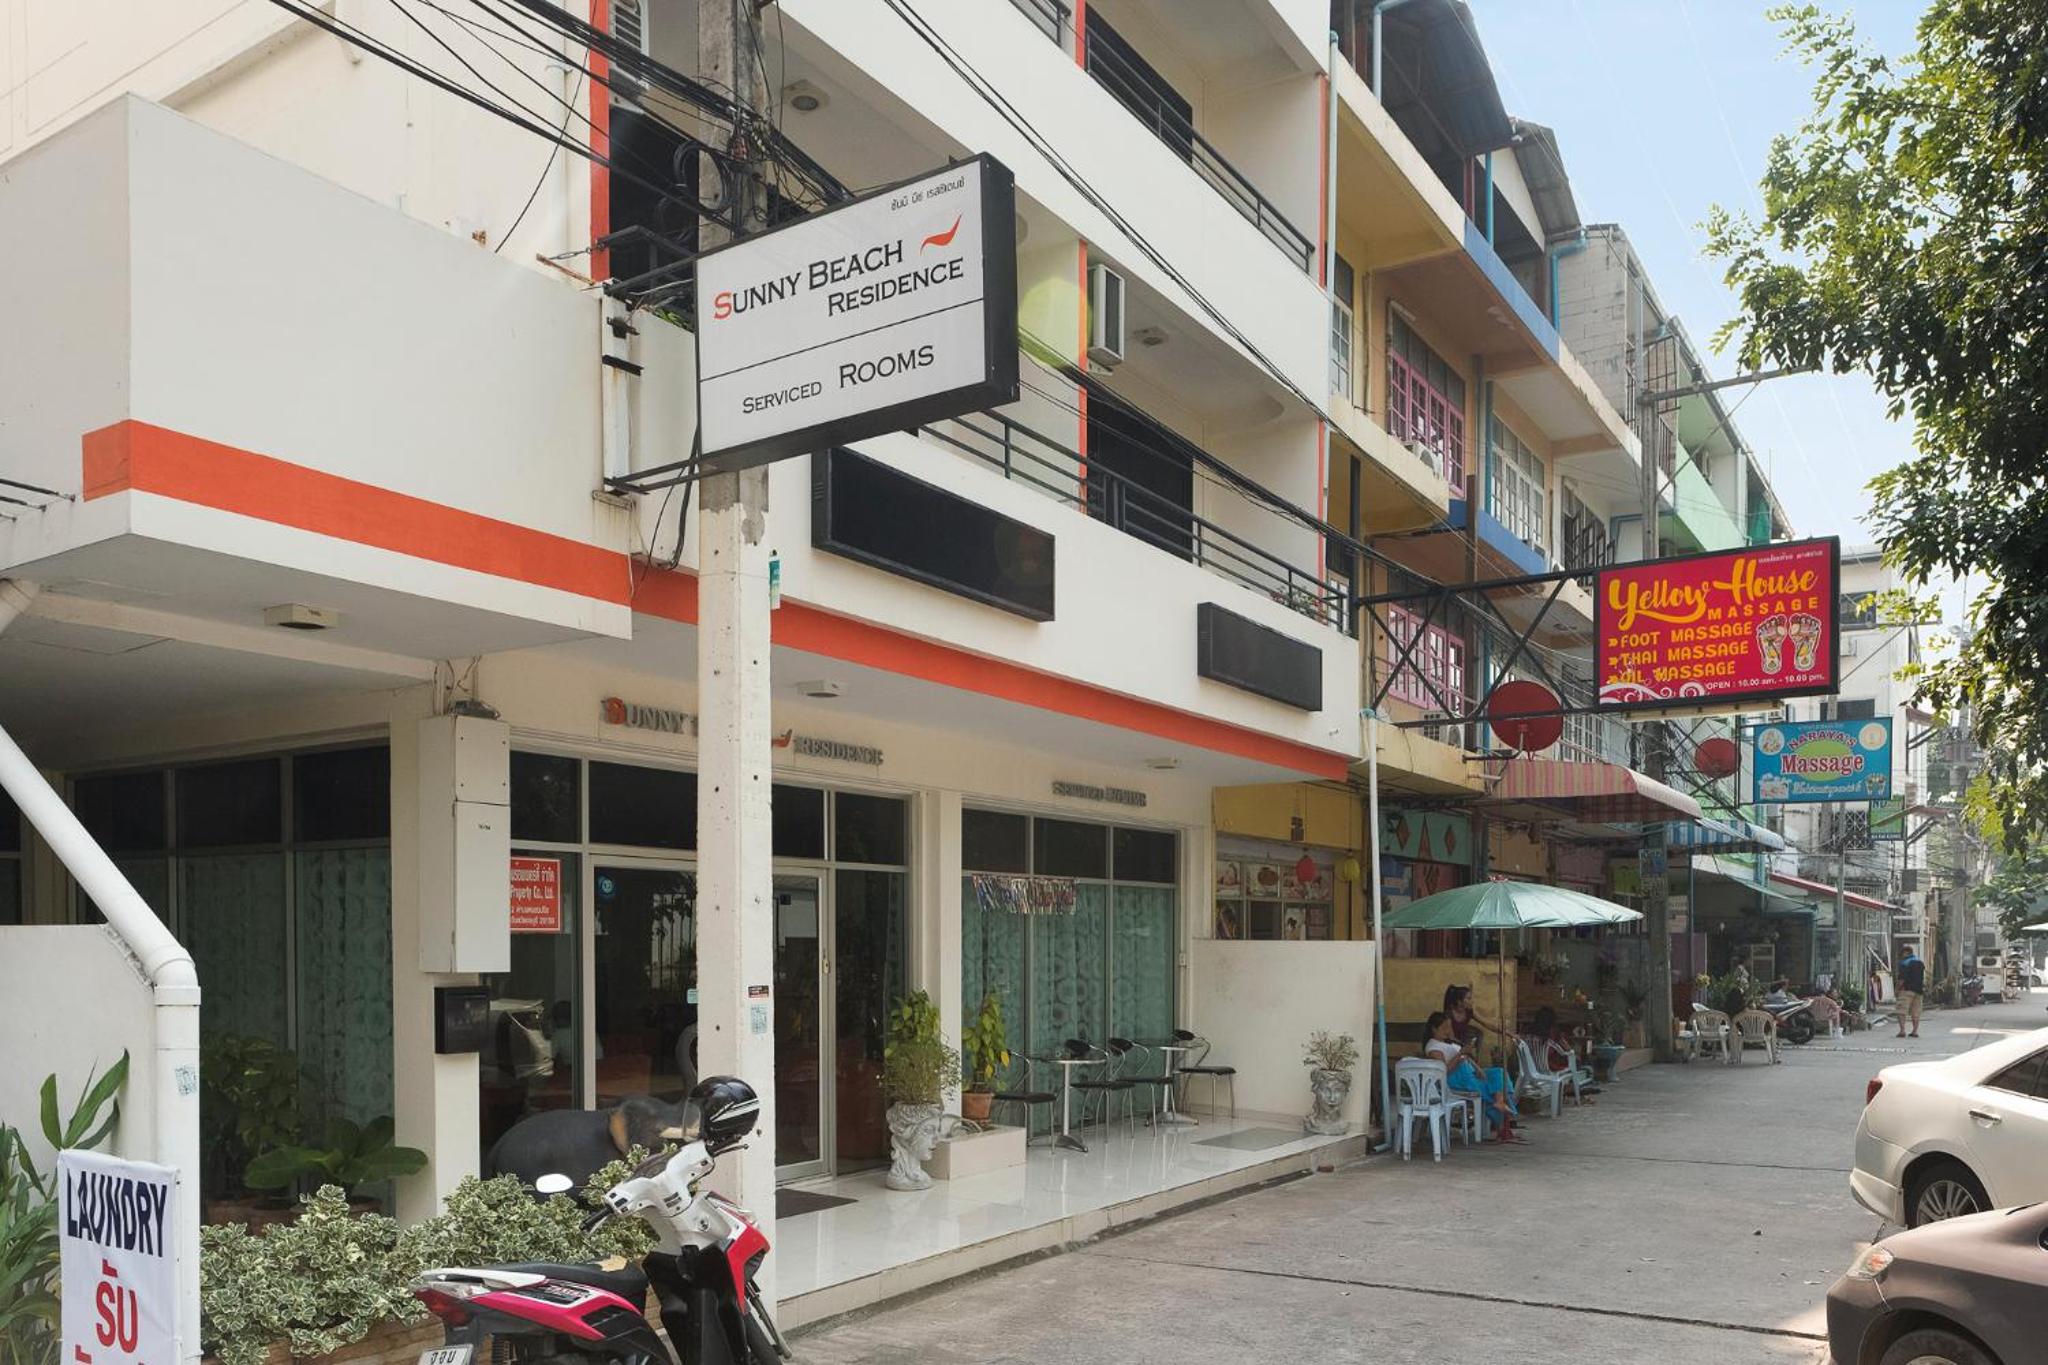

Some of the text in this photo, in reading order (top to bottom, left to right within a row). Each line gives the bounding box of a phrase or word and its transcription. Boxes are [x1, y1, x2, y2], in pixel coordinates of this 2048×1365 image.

[713, 240, 903, 320] SUNNY BEACH
[827, 257, 964, 316] RESIDENCE
[742, 345, 935, 414] SERVICED ROOMS
[1609, 558, 1818, 631] Yellow House
[1707, 596, 1819, 621] MASSAGE
[1621, 621, 1752, 648] FOOT MASSAGE
[1621, 641, 1750, 666] THAI MASSAGE
[1655, 661, 1736, 682] MASSAGE
[794, 736, 885, 766] RESIDENCE
[1781, 753, 1865, 776] Massage
[67, 1168, 168, 1258] LAUNDRY
